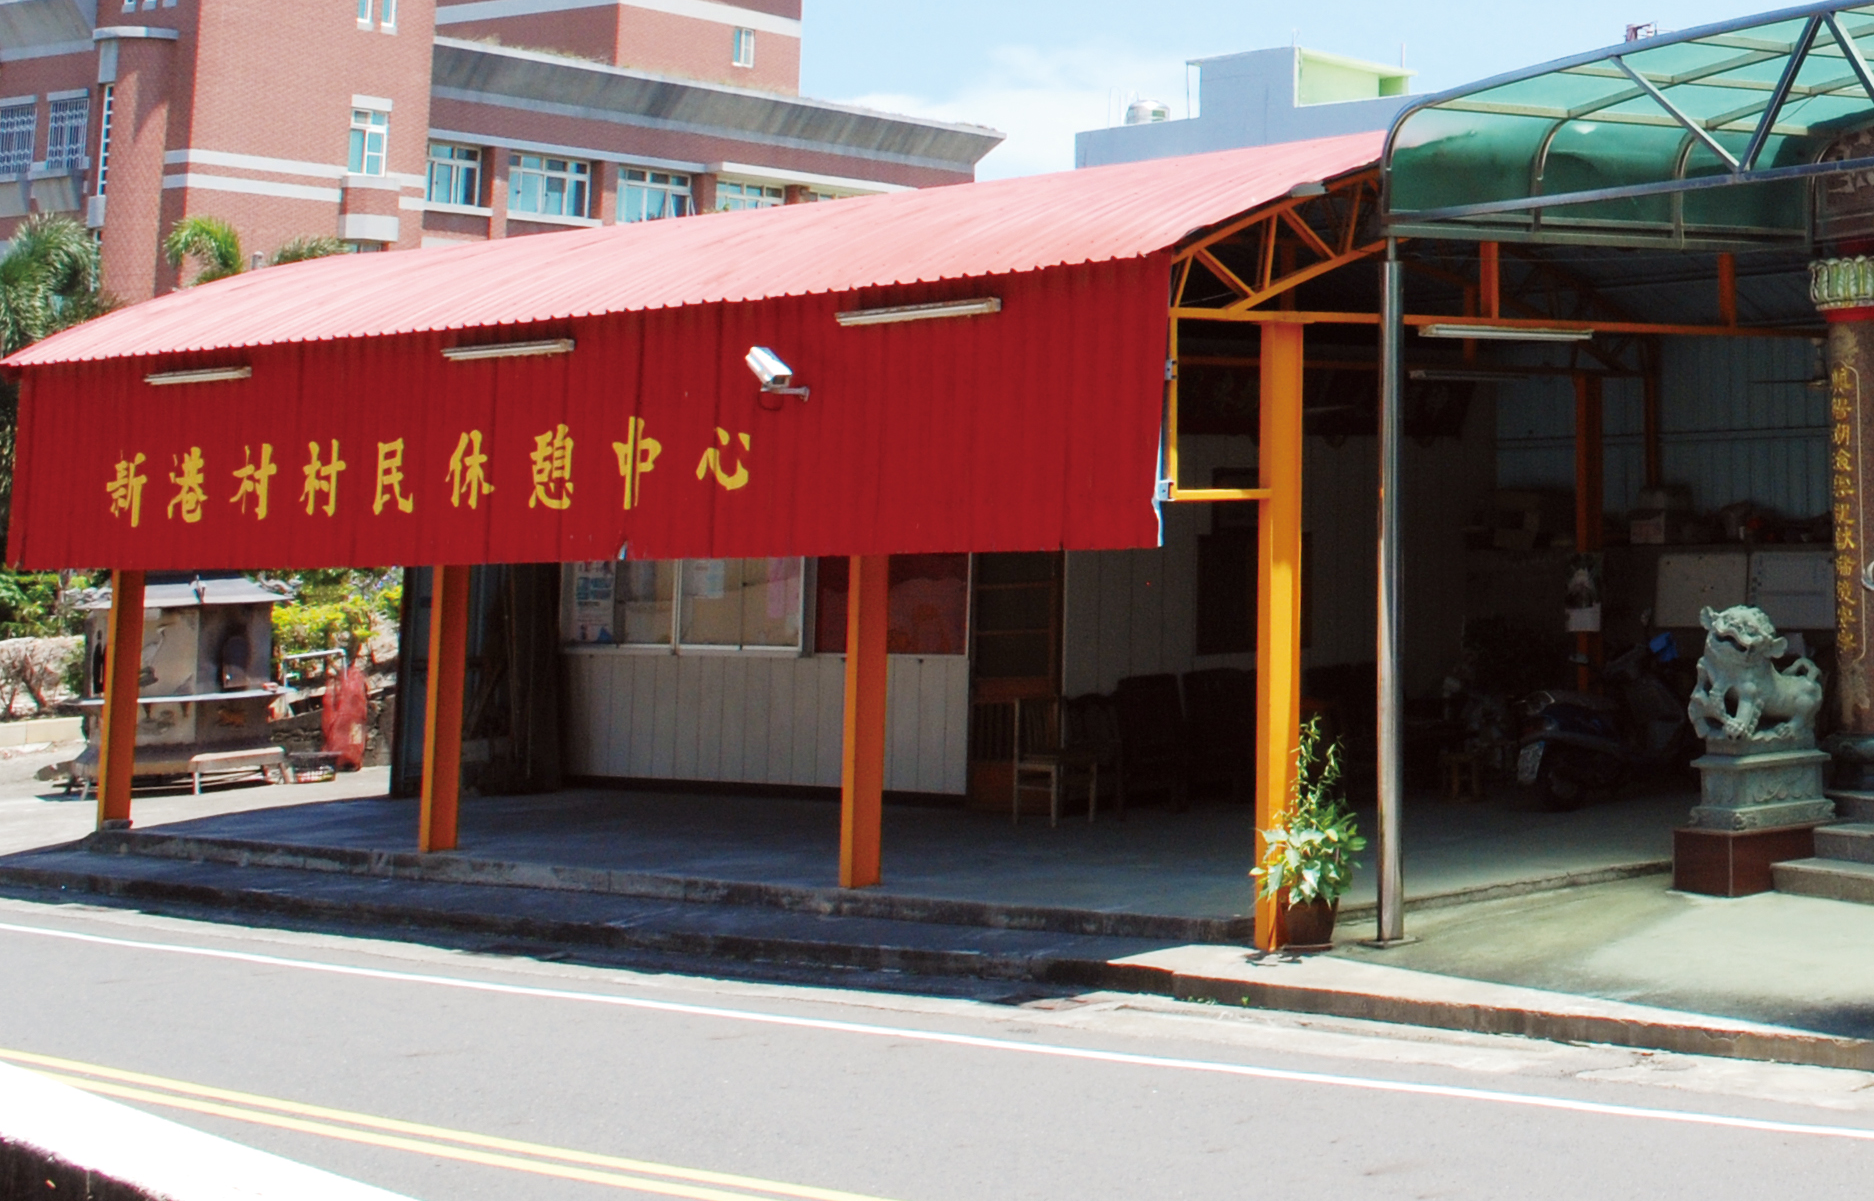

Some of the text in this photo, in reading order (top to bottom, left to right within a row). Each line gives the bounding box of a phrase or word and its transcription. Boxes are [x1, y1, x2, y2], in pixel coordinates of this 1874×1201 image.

[105, 415, 752, 529] 新港村村民休憩中心
